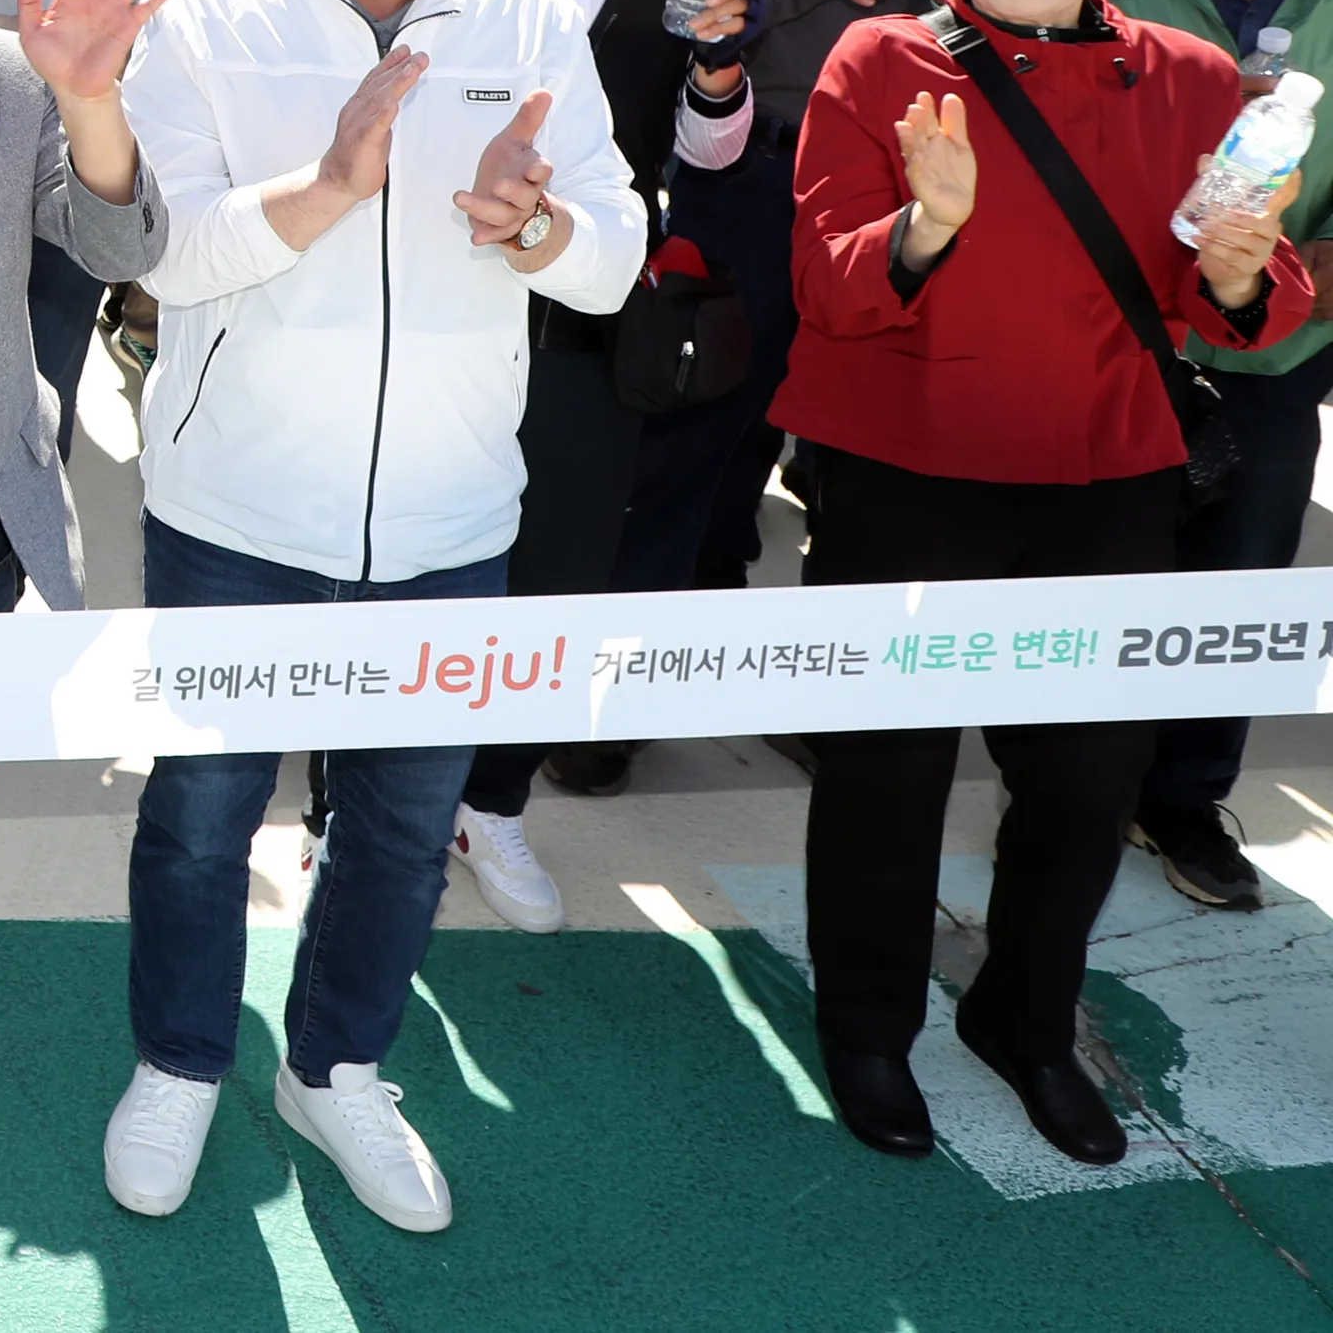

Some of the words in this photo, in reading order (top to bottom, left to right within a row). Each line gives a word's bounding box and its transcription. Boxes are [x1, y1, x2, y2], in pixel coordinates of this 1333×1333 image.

[478, 91, 509, 100] HAZZYS
[130, 666, 163, 703] 길
[172, 661, 277, 702] 위에서
[288, 659, 393, 699] 만나는
[396, 634, 568, 712] Jeju!
[592, 645, 727, 686] 거리에서
[734, 641, 871, 680] 시작되는
[880, 631, 998, 675] 새로운
[1010, 627, 1100, 671] 변화!
[1116, 620, 1307, 668] 2025년
